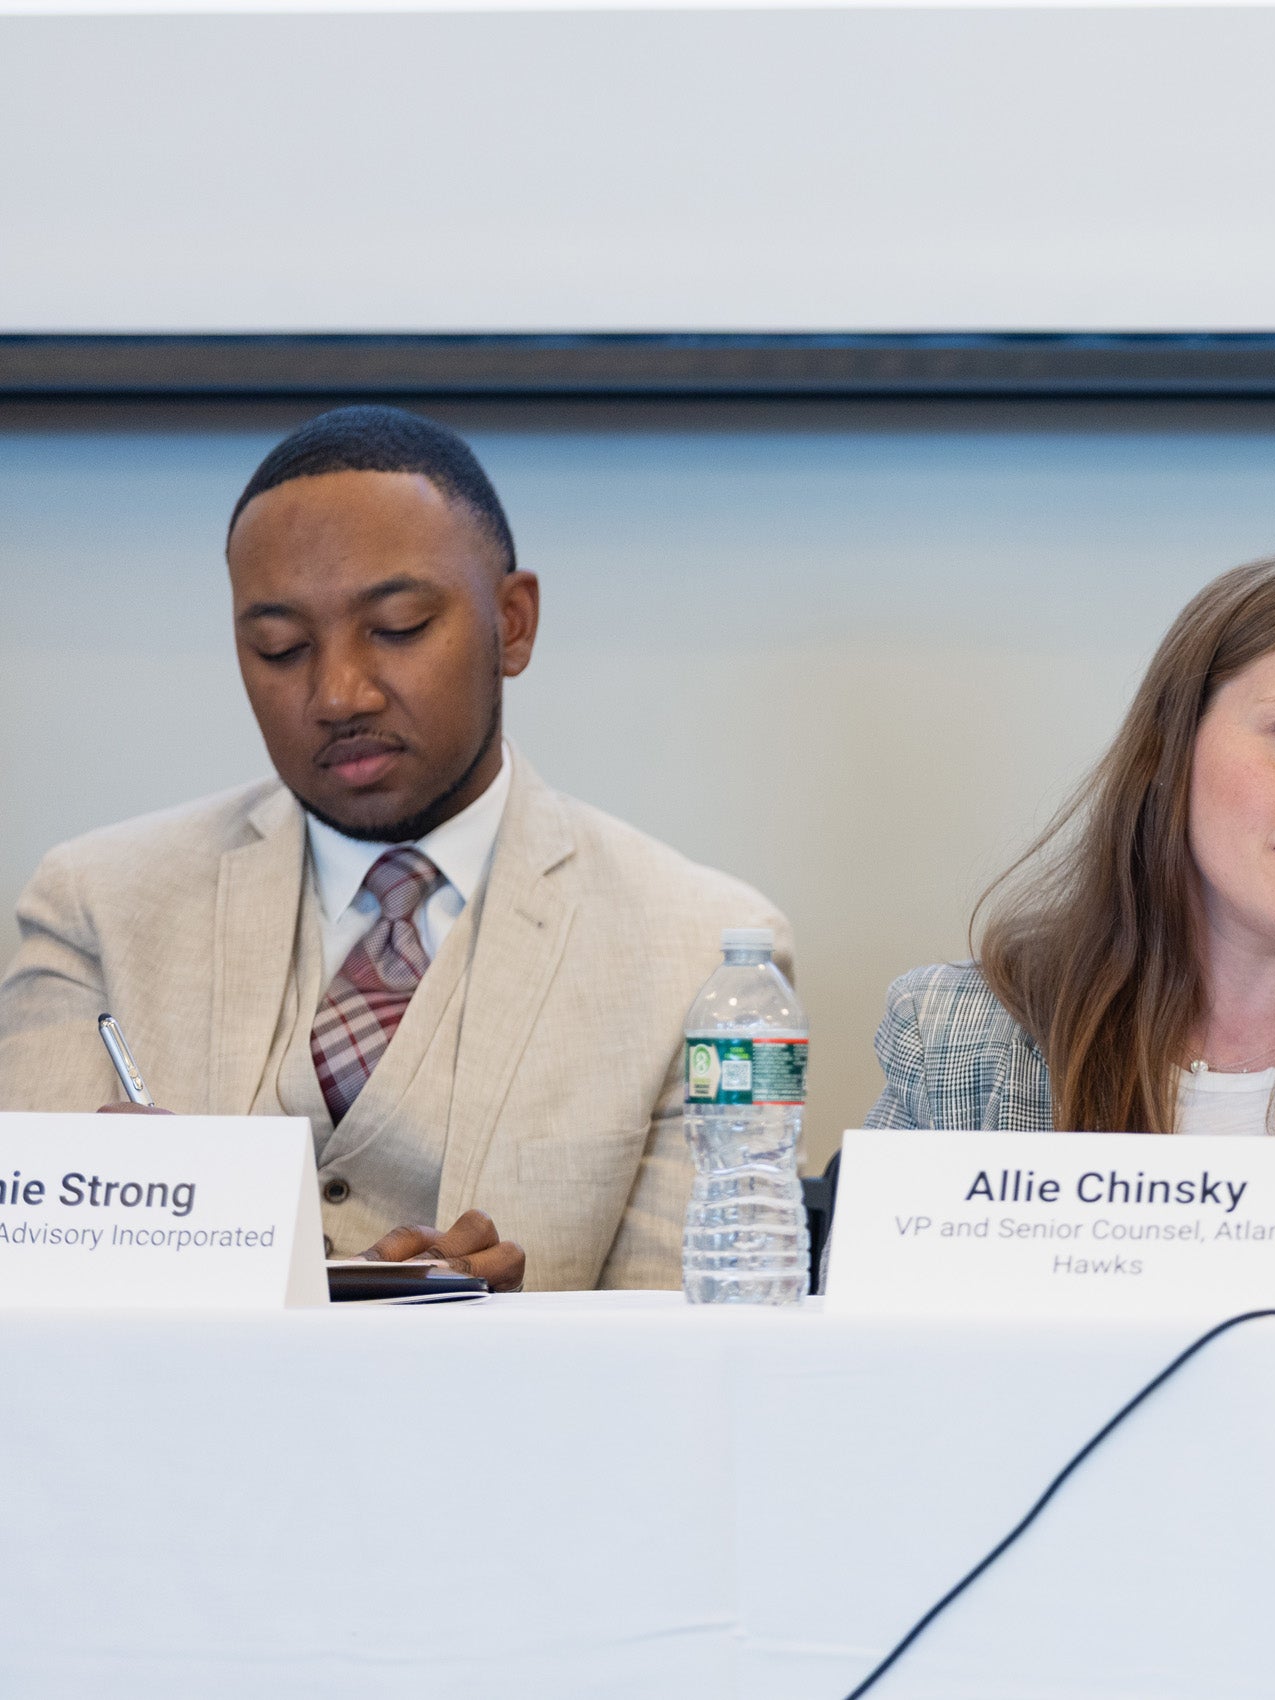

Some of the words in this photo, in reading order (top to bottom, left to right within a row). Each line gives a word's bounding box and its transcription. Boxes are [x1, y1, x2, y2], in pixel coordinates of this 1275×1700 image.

[59, 1172, 196, 1217] Strong
[964, 1169, 1061, 1203] Allie
[1077, 1170, 1248, 1213] Chinsky
[0, 1221, 104, 1251] Advisory
[112, 1224, 276, 1252] Incorporated
[895, 1216, 932, 1236] VP
[940, 1217, 989, 1238] and
[998, 1217, 1084, 1240] Senior
[1092, 1219, 1206, 1243] Counsel,
[1052, 1254, 1143, 1275] Hawks
